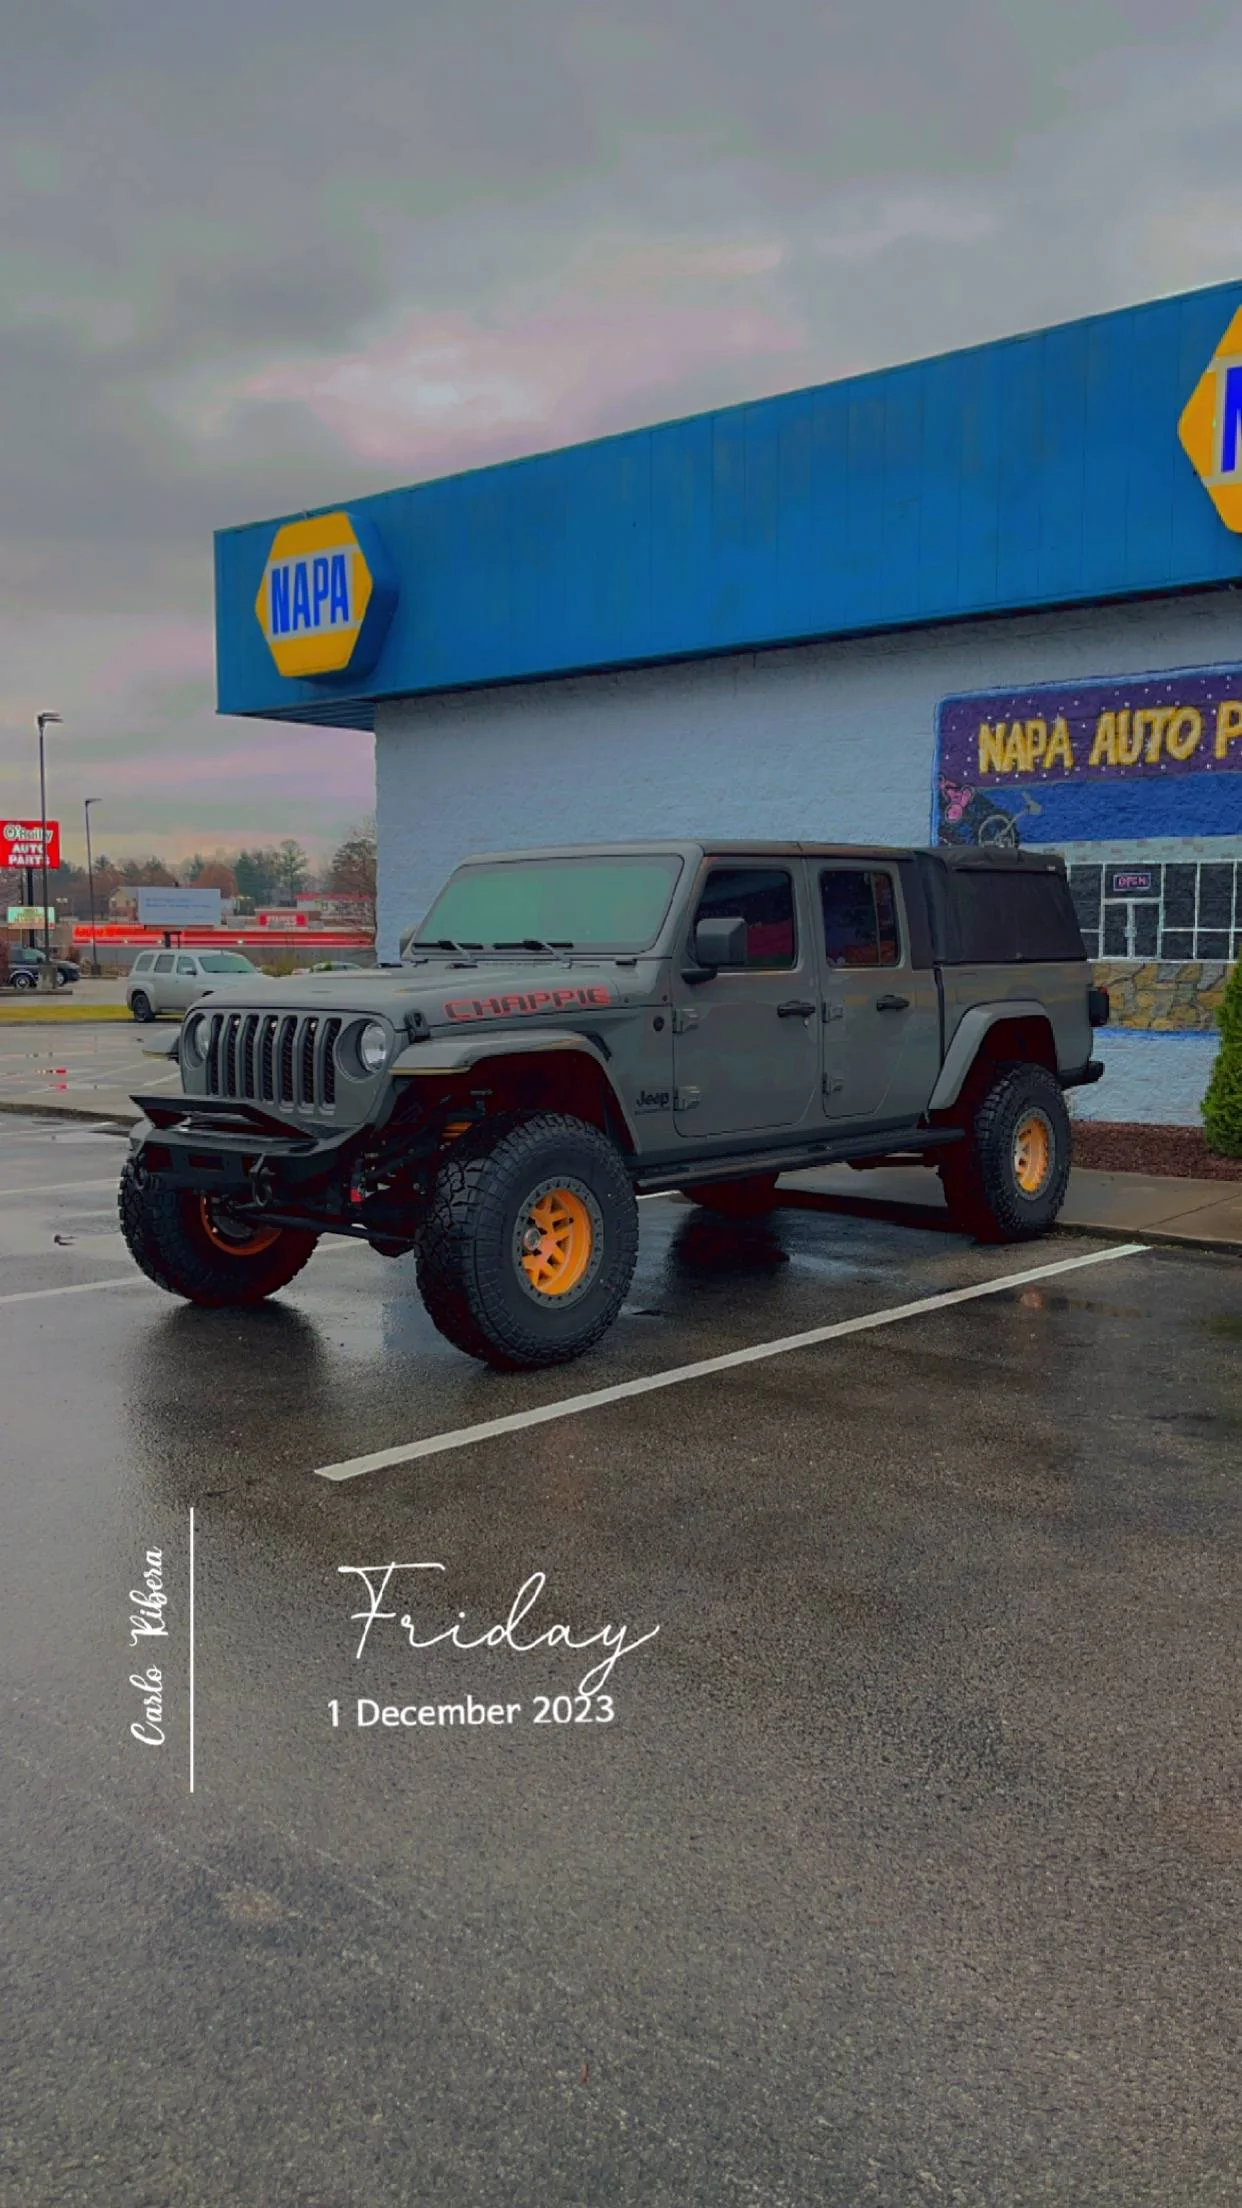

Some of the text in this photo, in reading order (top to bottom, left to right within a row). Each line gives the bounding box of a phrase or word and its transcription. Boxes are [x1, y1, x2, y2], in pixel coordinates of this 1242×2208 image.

[271, 554, 349, 635] NAPA
[979, 717, 1074, 773] NAPA
[1089, 706, 1202, 766] AUTO
[636, 1090, 669, 1108] Jeep
